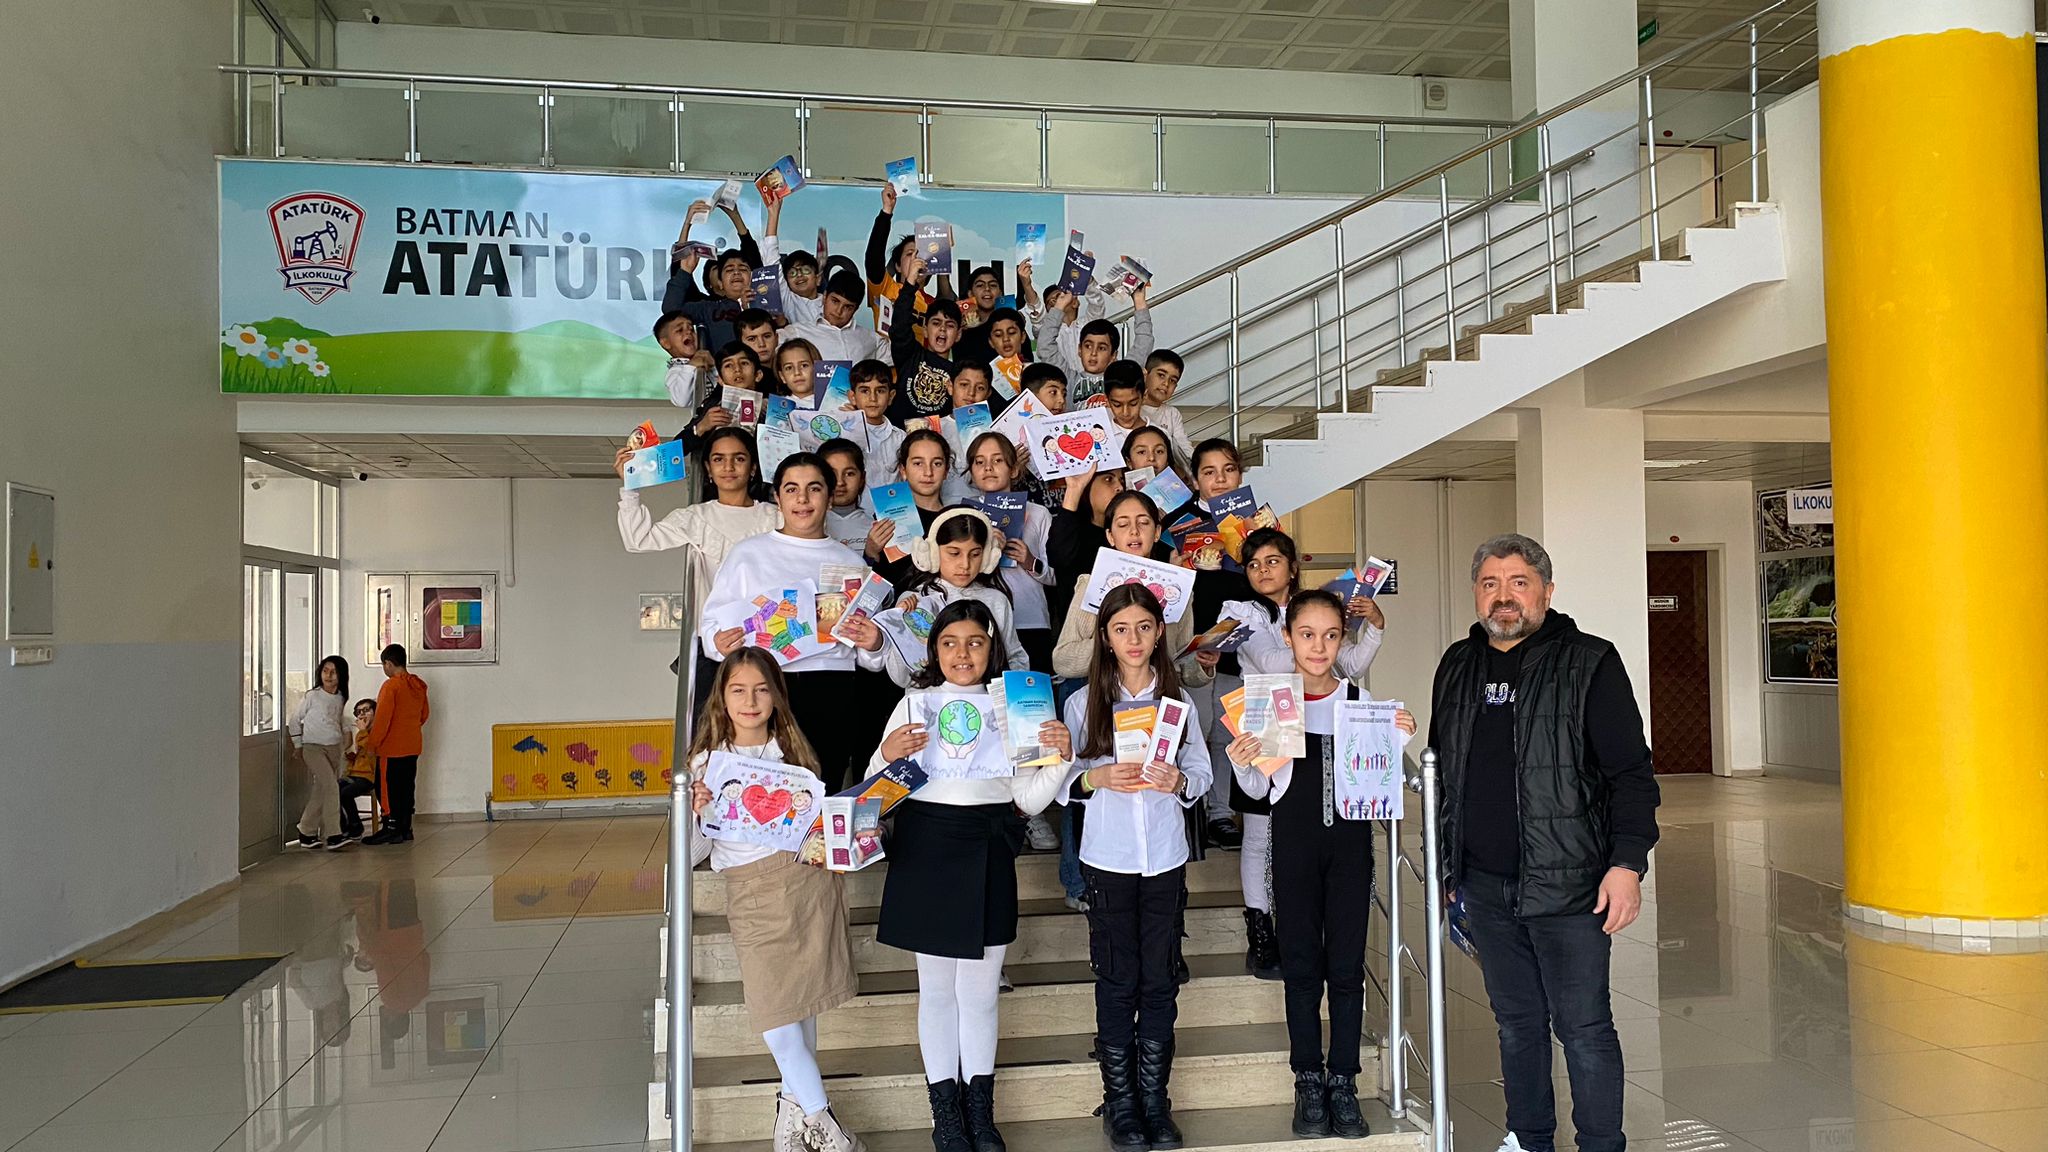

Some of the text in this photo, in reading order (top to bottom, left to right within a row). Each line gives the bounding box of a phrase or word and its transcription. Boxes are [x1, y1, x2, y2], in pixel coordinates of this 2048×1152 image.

[282, 200, 353, 223] ATATÜRK
[396, 207, 548, 238] BATMAN
[293, 271, 341, 282] İLKOKULU
